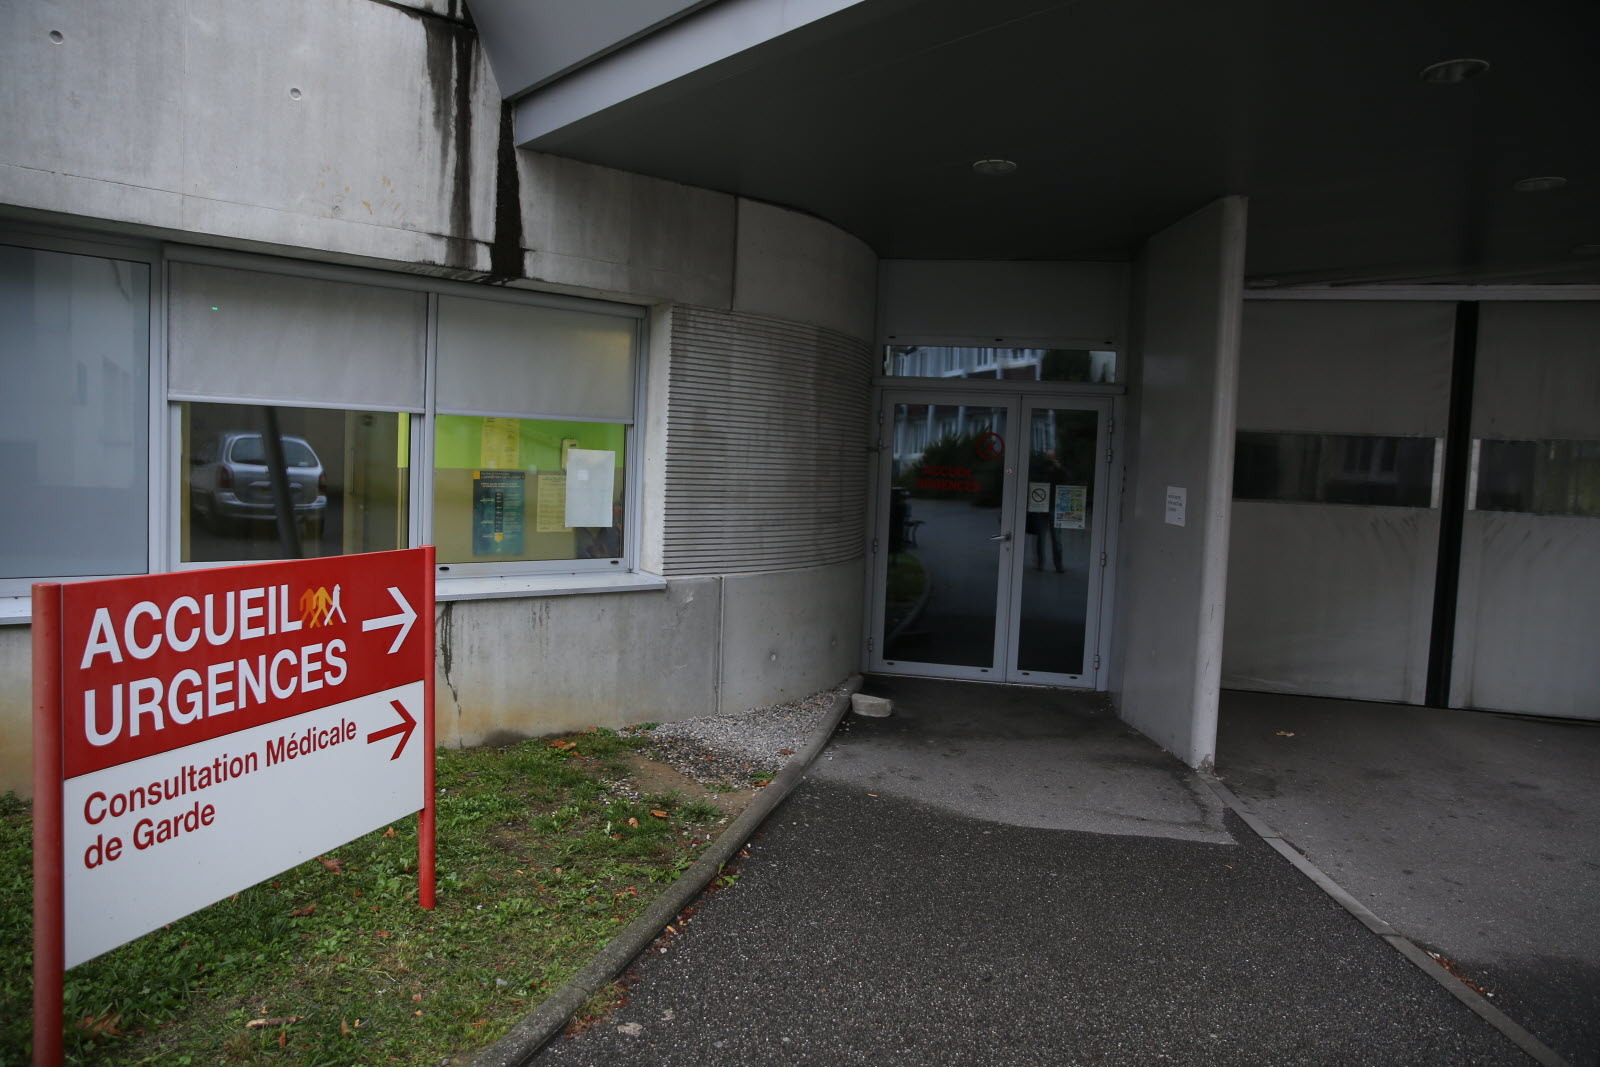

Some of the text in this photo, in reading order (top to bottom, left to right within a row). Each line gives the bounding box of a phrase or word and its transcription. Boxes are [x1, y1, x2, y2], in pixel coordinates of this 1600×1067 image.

[80, 584, 303, 670] ACCUEIL
[84, 638, 347, 748] URGENCES
[84, 717, 357, 826] Consultation Médicale
[84, 800, 216, 870] de Garde
